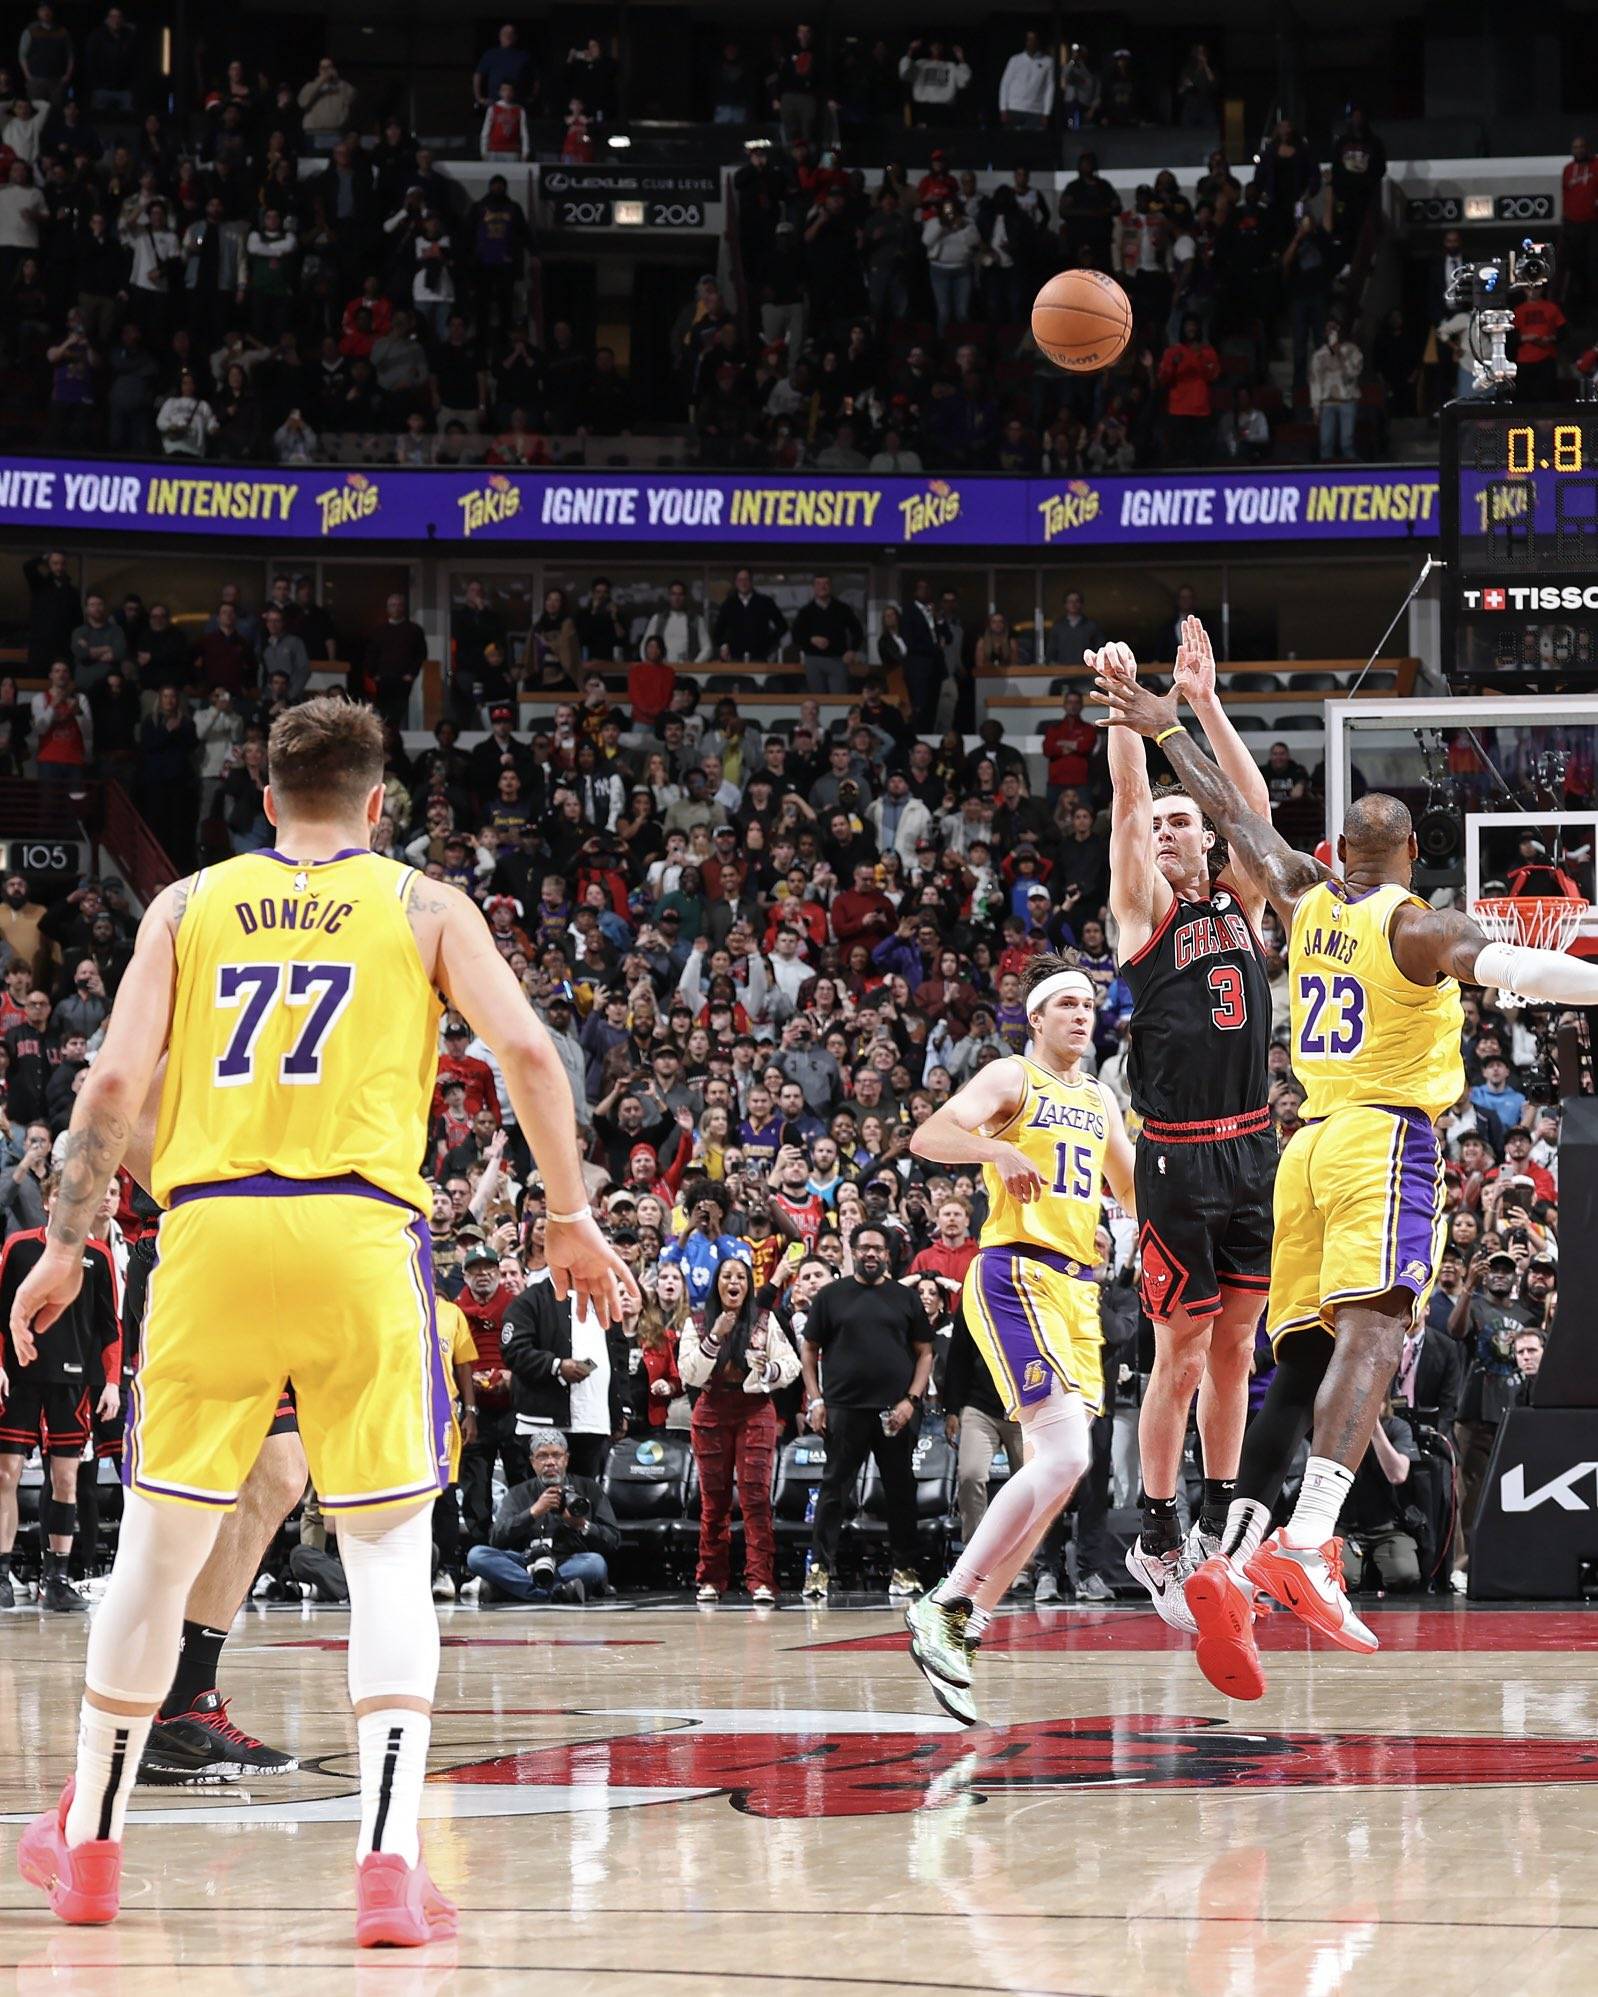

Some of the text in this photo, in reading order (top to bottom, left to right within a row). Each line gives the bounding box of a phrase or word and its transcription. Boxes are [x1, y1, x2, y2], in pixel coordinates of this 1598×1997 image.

[571, 177, 713, 190] LEXUS CLUB LEVEL
[563, 203, 605, 223] 207
[653, 204, 700, 224] 208
[1502, 197, 1549, 217] 209
[1508, 426, 1581, 473] 0.8
[63, 473, 141, 513] YOUR
[146, 478, 298, 520] INTENSITY
[315, 485, 379, 535] Takis
[457, 486, 521, 537] Takis
[541, 488, 881, 527] IGNITE YOUR INTENSITY
[898, 491, 962, 541] Takis
[1038, 491, 1101, 541] Takis
[1120, 484, 1440, 526] IGNITE YOUR INTENSIT
[1508, 586, 1598, 610] TISSO
[23, 845, 67, 869] 105
[235, 893, 360, 935] DONČIĆ
[1304, 928, 1358, 964] JAMES
[1208, 965, 1247, 1030] 3
[1298, 974, 1366, 1060] 23
[214, 961, 355, 1087] 77
[1026, 1095, 1104, 1140] LAKERS
[1051, 1141, 1092, 1199] 15
